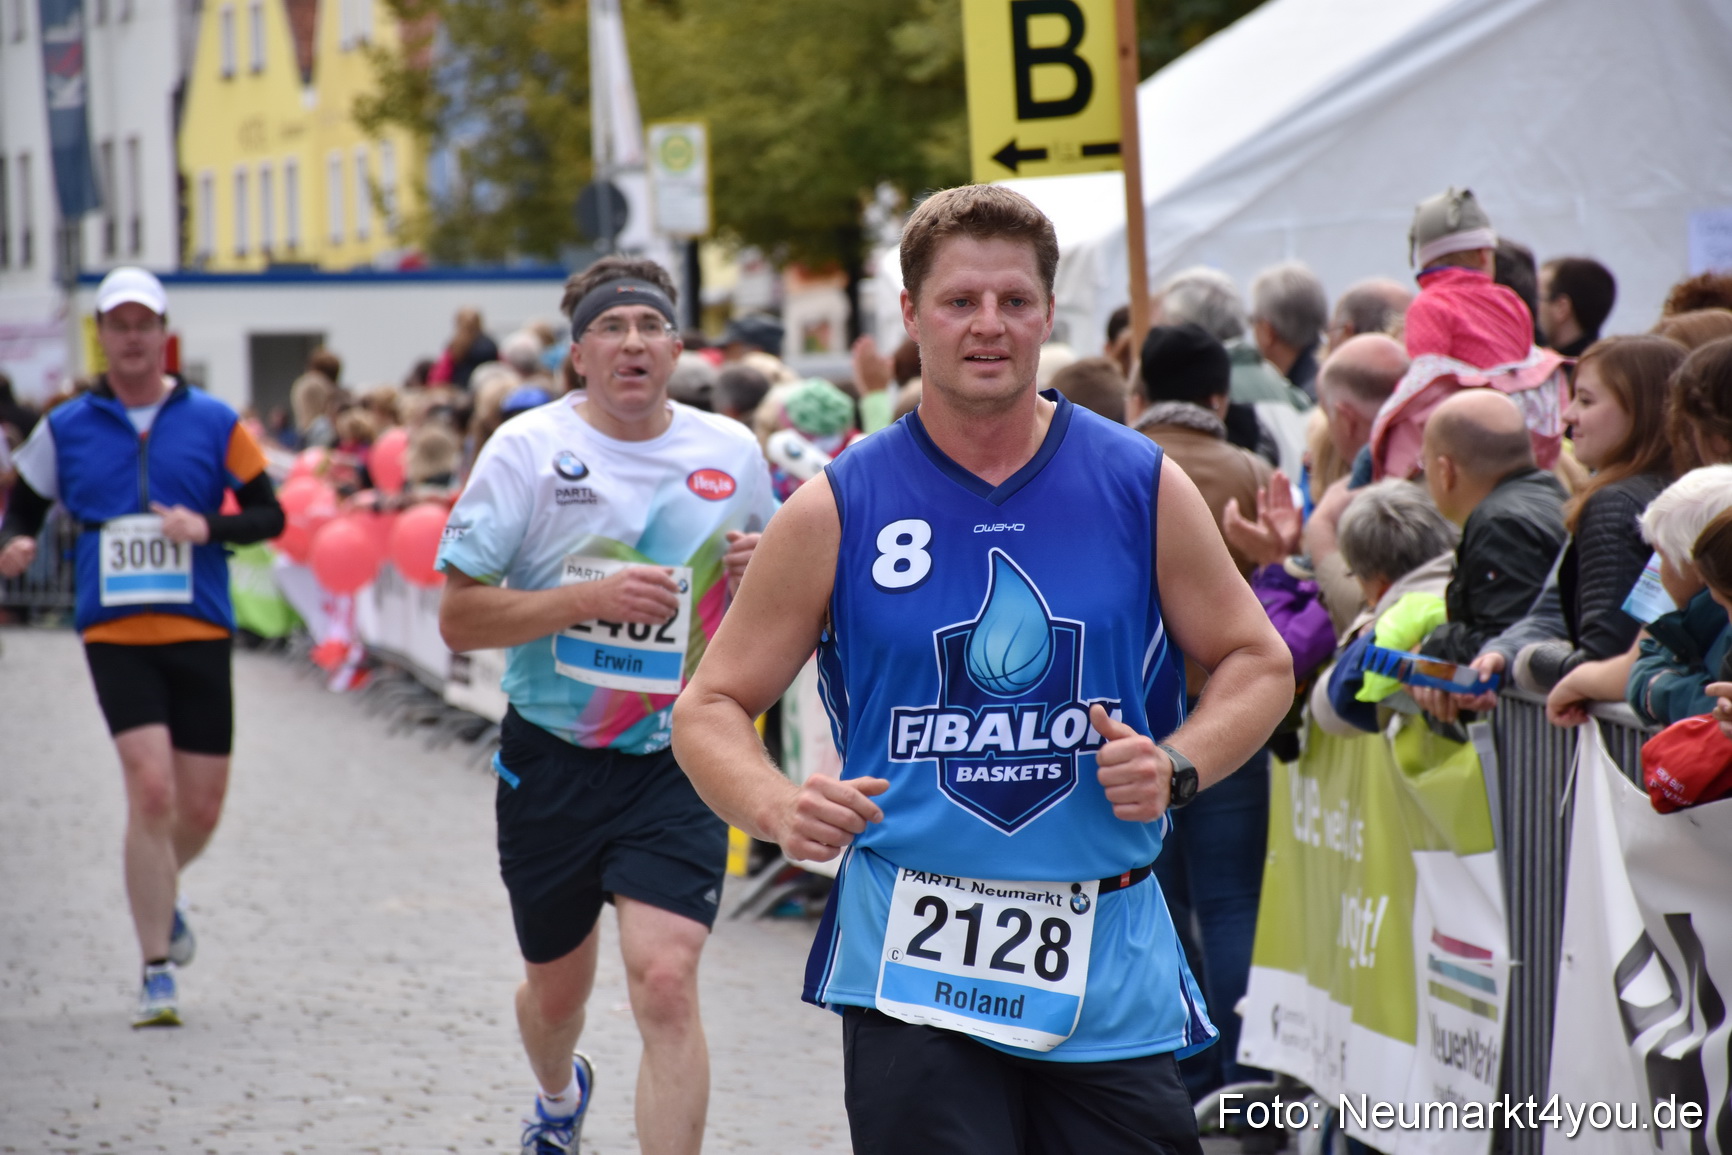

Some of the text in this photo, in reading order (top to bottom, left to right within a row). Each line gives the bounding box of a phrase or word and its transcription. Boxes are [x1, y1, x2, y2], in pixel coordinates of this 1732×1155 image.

[1010, 0, 1093, 120] B
[555, 488, 598, 499] PARTL
[110, 537, 181, 570] 3001
[871, 518, 933, 591] 8
[593, 649, 643, 673] Erwin
[956, 763, 1062, 783] BASKETS
[902, 868, 966, 891] PARTL
[971, 881, 1063, 907] Neumarkt
[906, 895, 1072, 982] 2128
[934, 980, 1025, 1019] Roland
